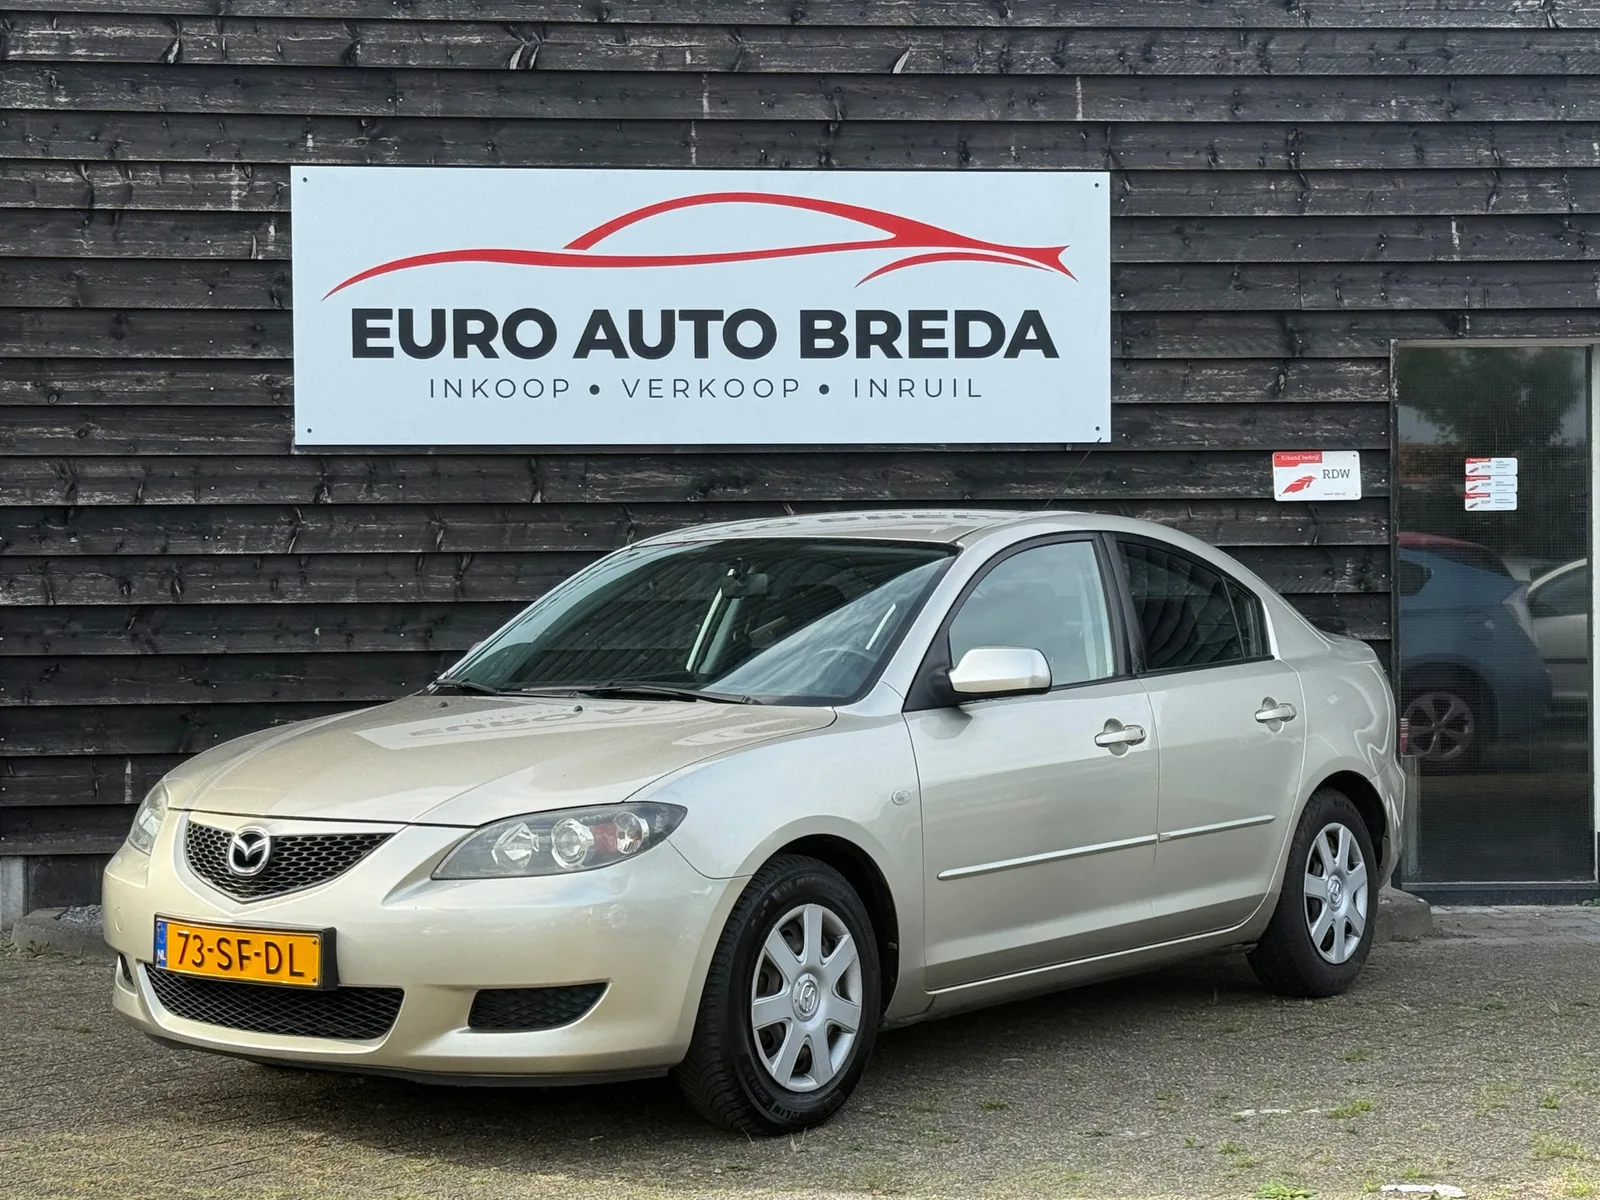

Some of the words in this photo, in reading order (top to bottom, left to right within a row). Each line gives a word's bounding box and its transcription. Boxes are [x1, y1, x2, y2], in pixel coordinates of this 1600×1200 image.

[352, 307, 558, 360] EURO
[572, 308, 778, 360] AUTO
[800, 309, 1060, 359] BREDA
[430, 378, 569, 399] INKOOP
[621, 378, 800, 398] VERKOOP
[854, 378, 982, 398] INRUIL
[1322, 469, 1351, 479] RDW
[157, 949, 167, 961] NL
[177, 930, 305, 977] 73-SF-DL
